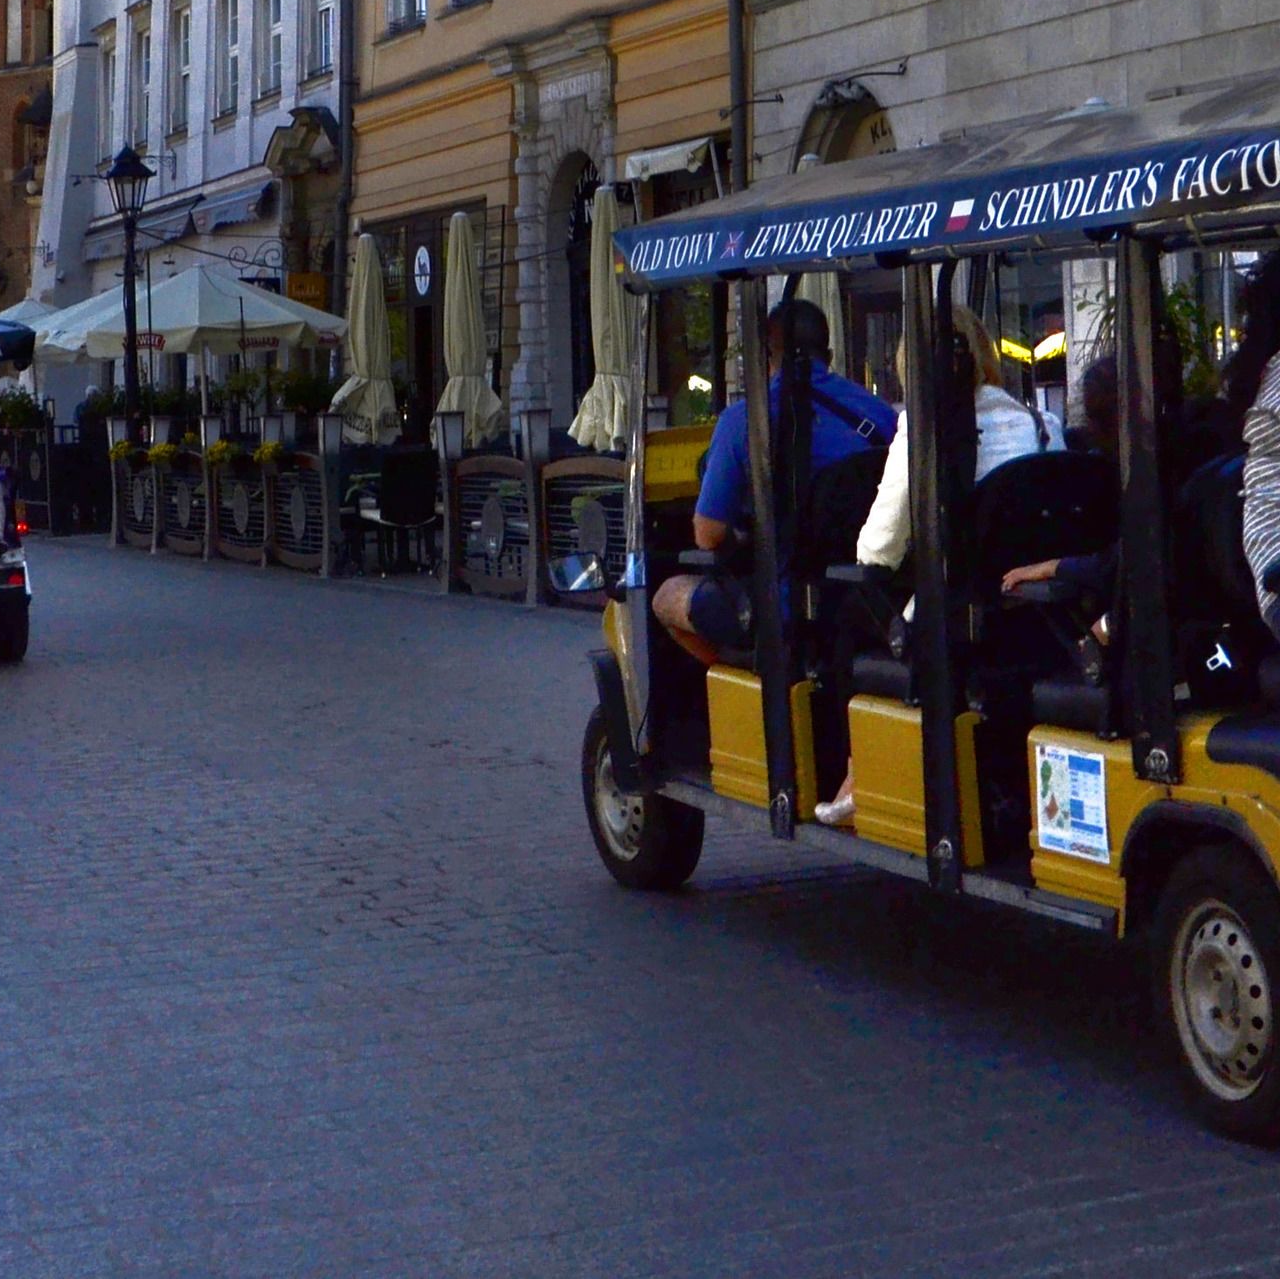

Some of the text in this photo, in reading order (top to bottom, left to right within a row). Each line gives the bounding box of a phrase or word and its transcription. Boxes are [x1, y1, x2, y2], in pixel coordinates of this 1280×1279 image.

[630, 240, 662, 274] OLD
[665, 231, 720, 269] TOWN
[744, 218, 828, 259] JEWISH
[827, 201, 938, 257] QUARTER
[978, 160, 1166, 231] SCHINDLER'S
